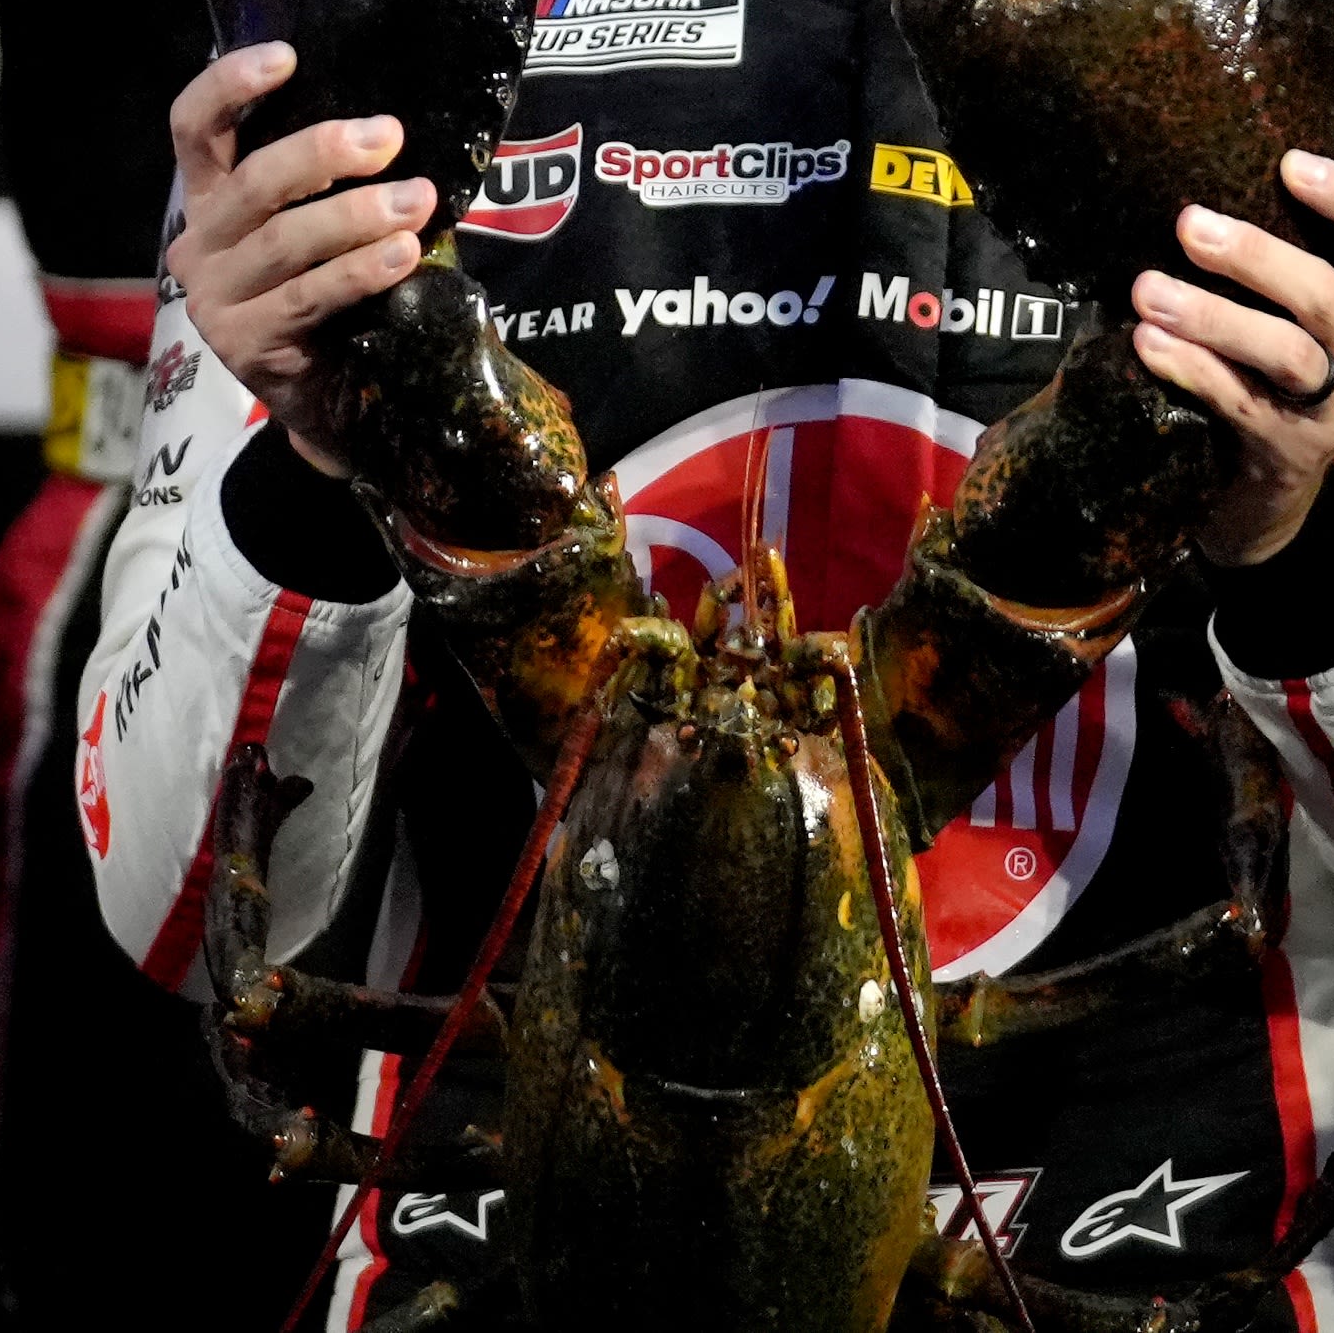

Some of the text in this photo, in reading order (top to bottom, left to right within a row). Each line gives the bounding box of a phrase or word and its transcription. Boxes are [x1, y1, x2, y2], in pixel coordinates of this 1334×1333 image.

[531, 20, 707, 52] UP SERIES
[600, 145, 843, 186] SportClips
[650, 183, 779, 198] HAIRCUTS
[614, 275, 838, 337] yahoo!
[857, 272, 1006, 339] Mobil
